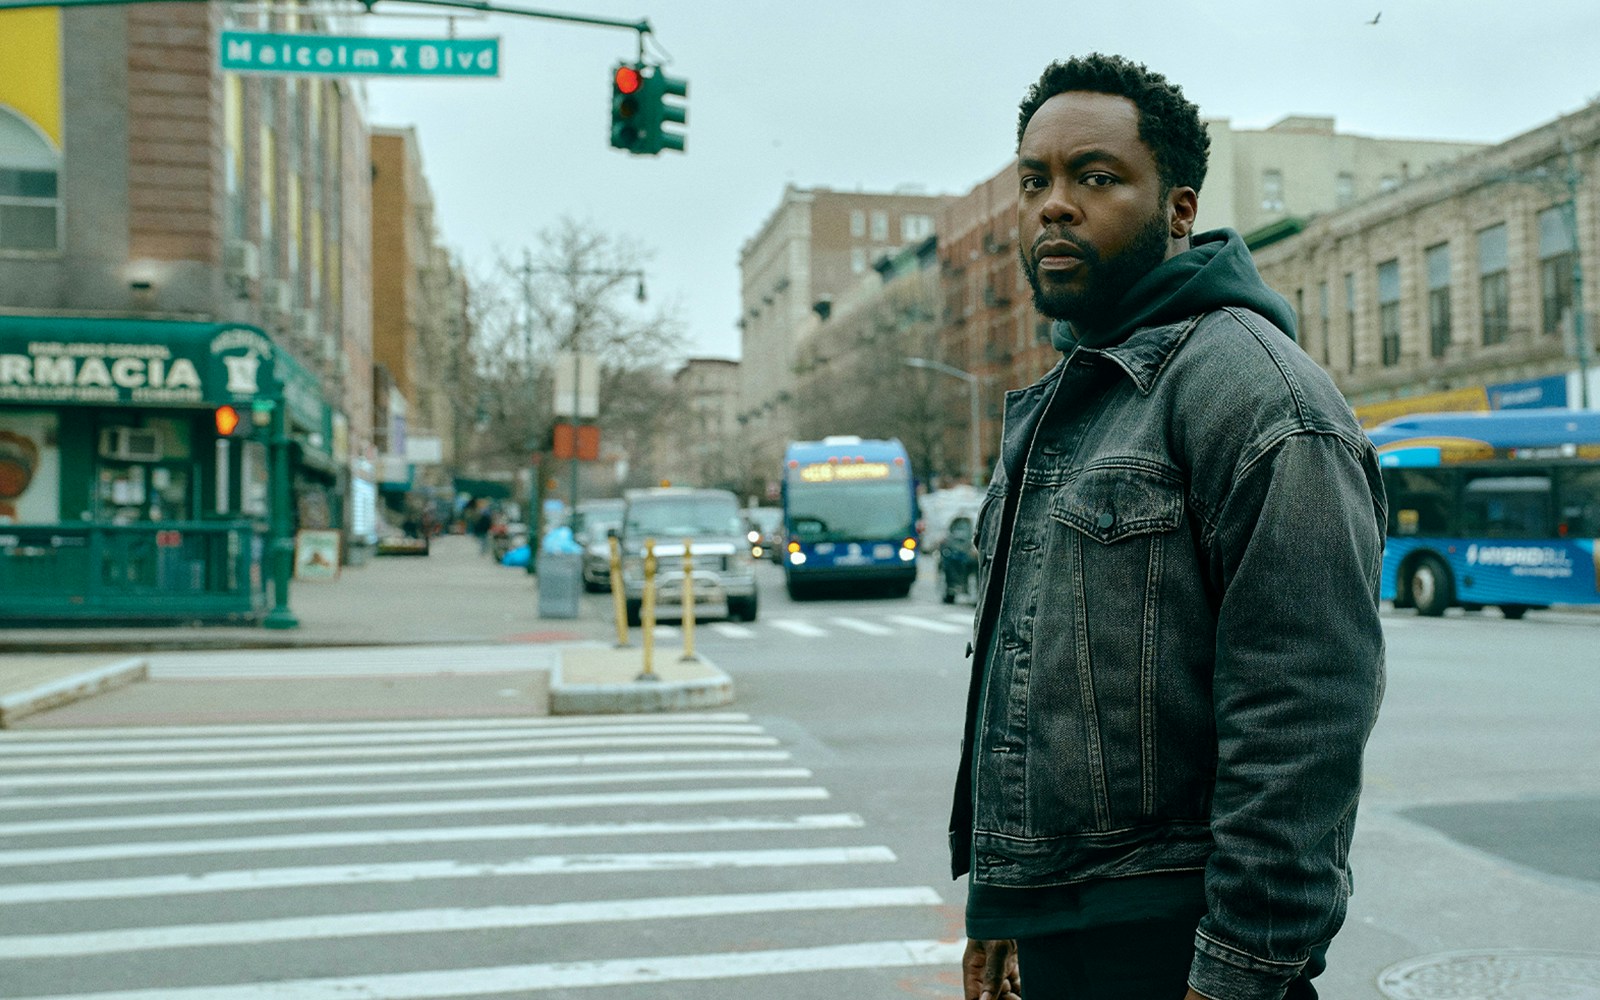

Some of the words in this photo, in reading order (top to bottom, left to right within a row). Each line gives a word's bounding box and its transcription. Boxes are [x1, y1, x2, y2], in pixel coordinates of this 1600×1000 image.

[227, 39, 380, 67] Malcolm
[390, 46, 407, 68] X
[418, 45, 493, 70] Blvd
[0, 354, 202, 388] RMACIA
